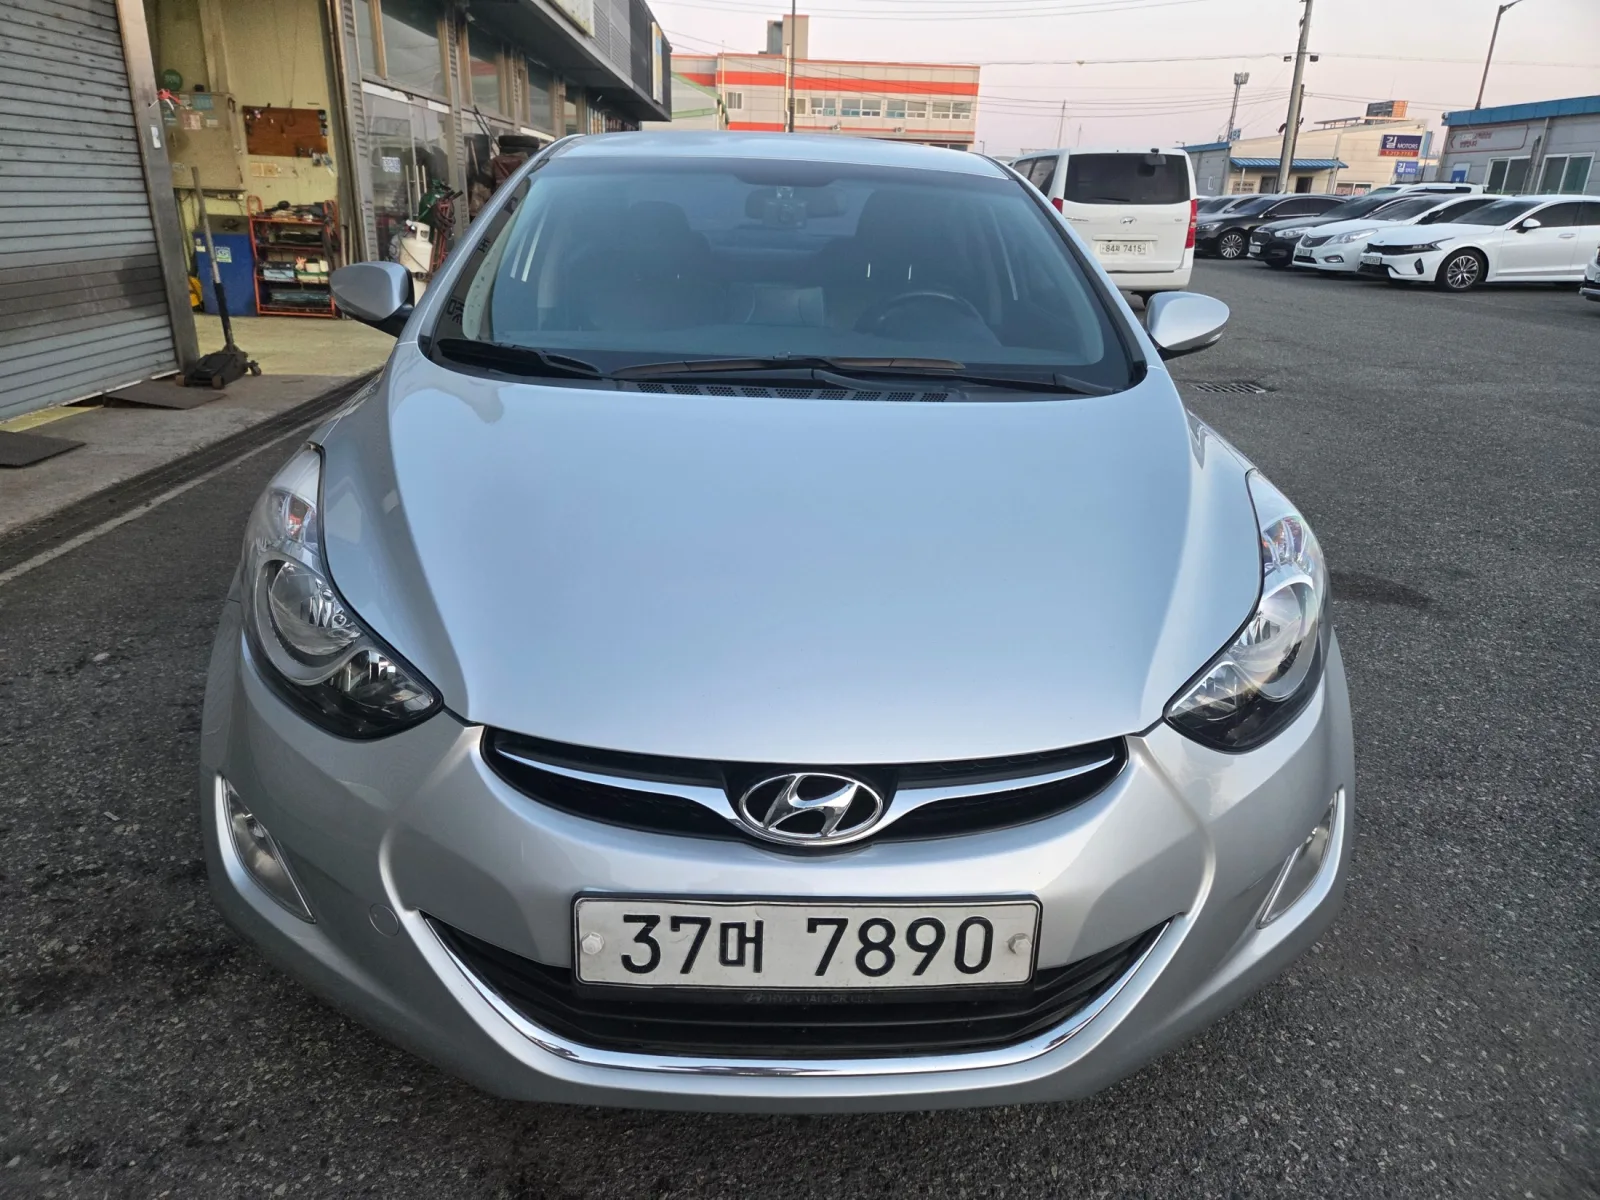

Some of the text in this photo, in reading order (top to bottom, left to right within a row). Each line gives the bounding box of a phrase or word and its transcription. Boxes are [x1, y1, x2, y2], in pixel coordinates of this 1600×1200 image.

[1386, 136, 1397, 148] 길
[1123, 244, 1142, 252] 7415
[620, 913, 994, 977] 37머 7890
